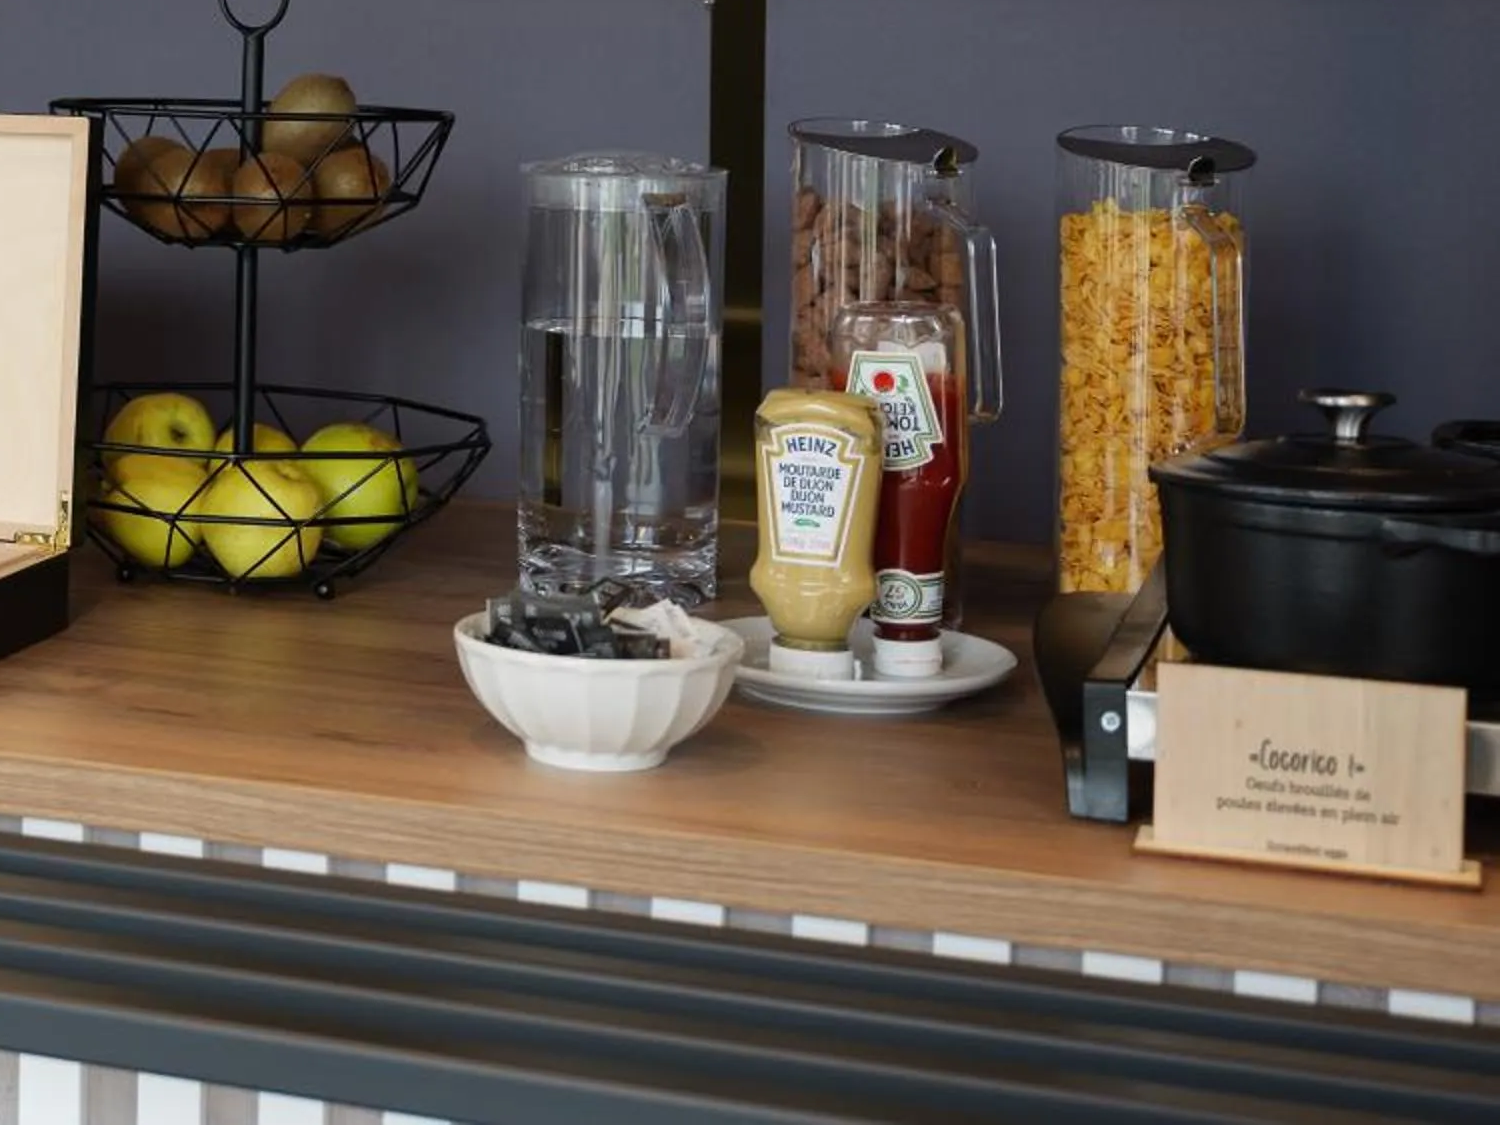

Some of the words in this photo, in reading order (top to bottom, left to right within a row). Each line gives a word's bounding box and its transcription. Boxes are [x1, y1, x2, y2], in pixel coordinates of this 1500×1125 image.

[881, 402, 917, 416] KETC
[887, 416, 921, 432] TOM
[785, 436, 838, 457] HEINZ
[779, 462, 842, 480] MOUTARDE
[783, 476, 797, 488] DE
[799, 477, 834, 492] DIJON
[790, 489, 825, 504] DIJON
[781, 501, 835, 518] MUSTARD
[1354, 788, 1372, 802] de
[1216, 796, 1262, 812] poules
[1320, 807, 1338, 819] en
[1341, 807, 1378, 824] plein
[1380, 811, 1401, 826] air
